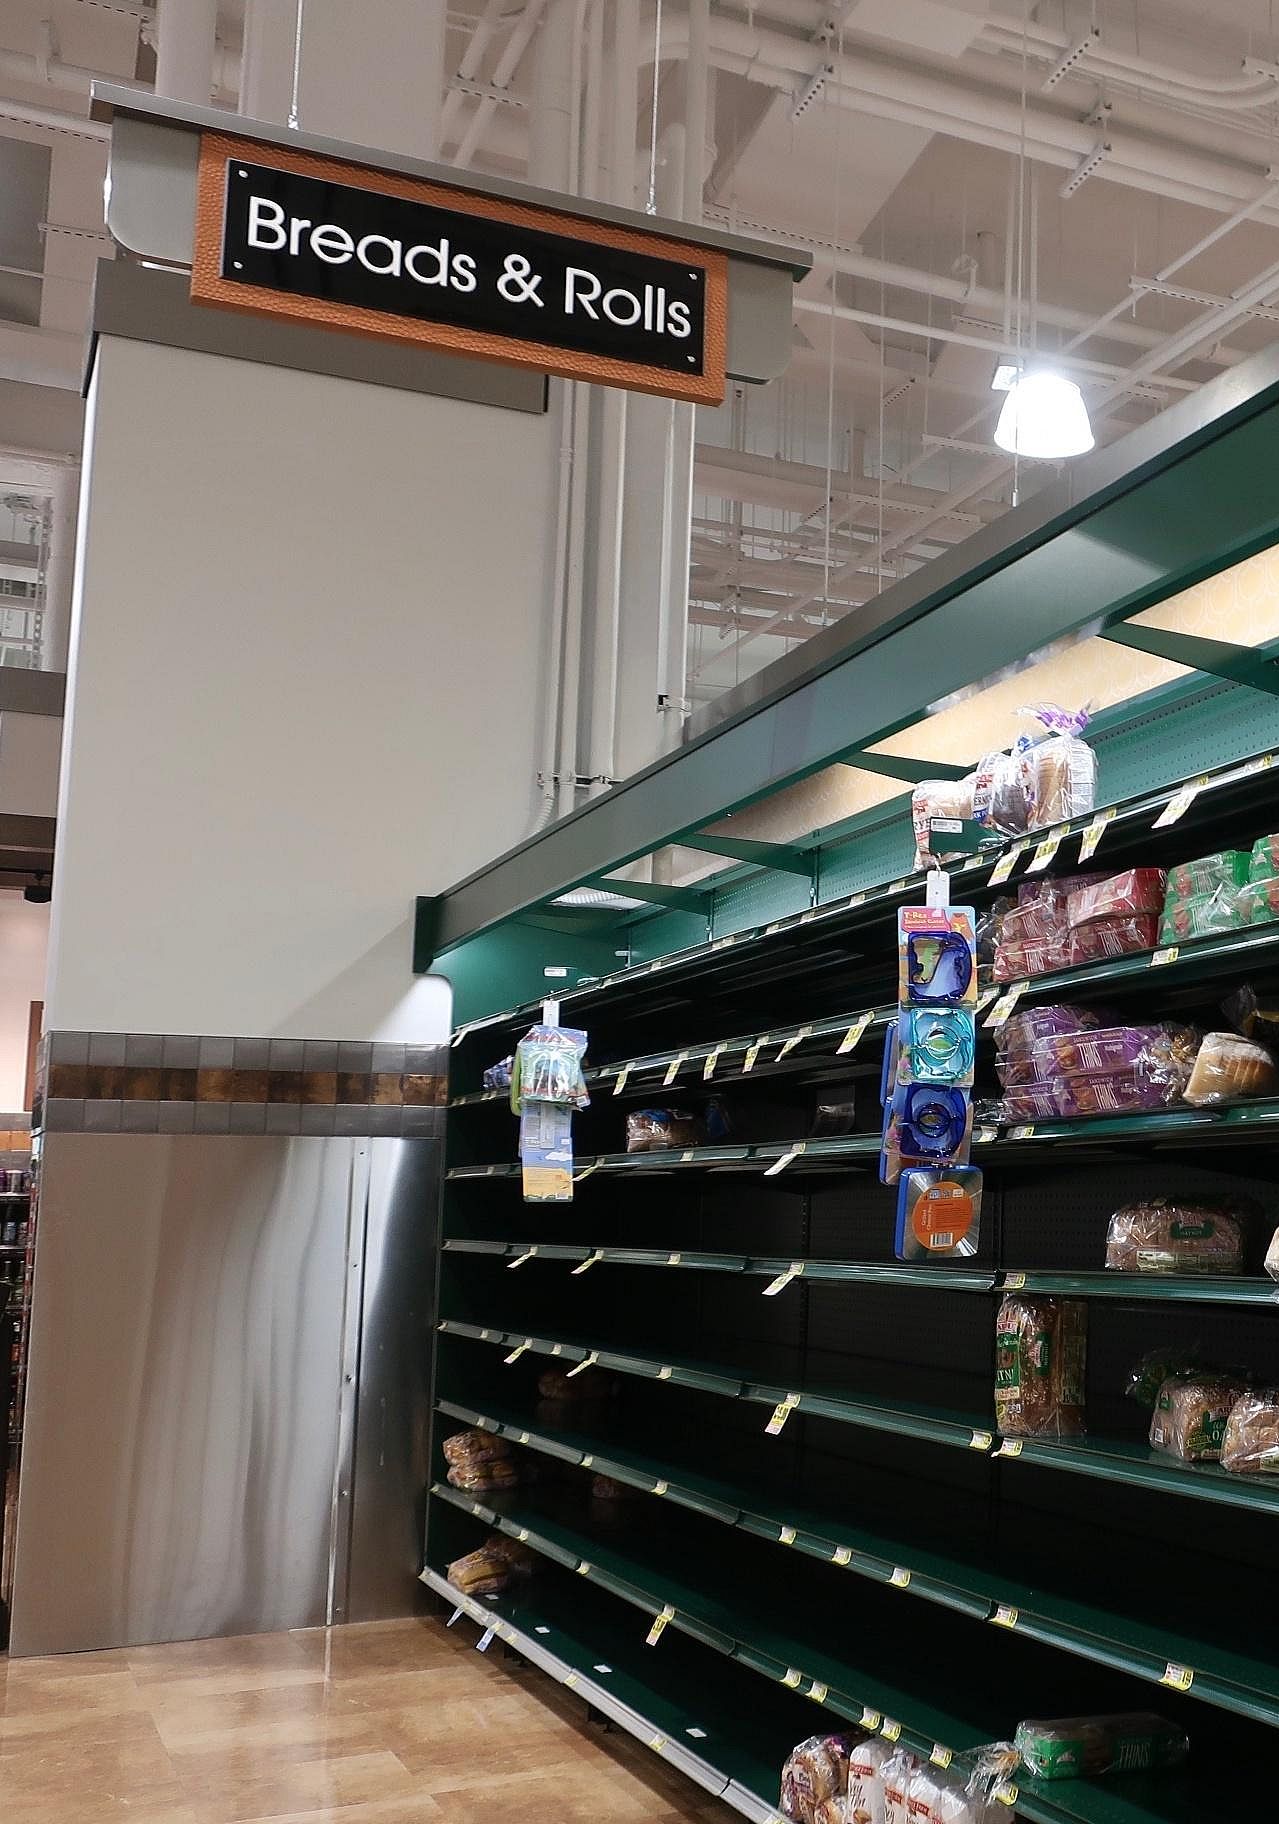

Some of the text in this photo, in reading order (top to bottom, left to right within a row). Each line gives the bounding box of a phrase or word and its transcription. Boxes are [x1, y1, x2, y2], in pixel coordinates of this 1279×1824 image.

[247, 195, 692, 338] Breads & Rolls
